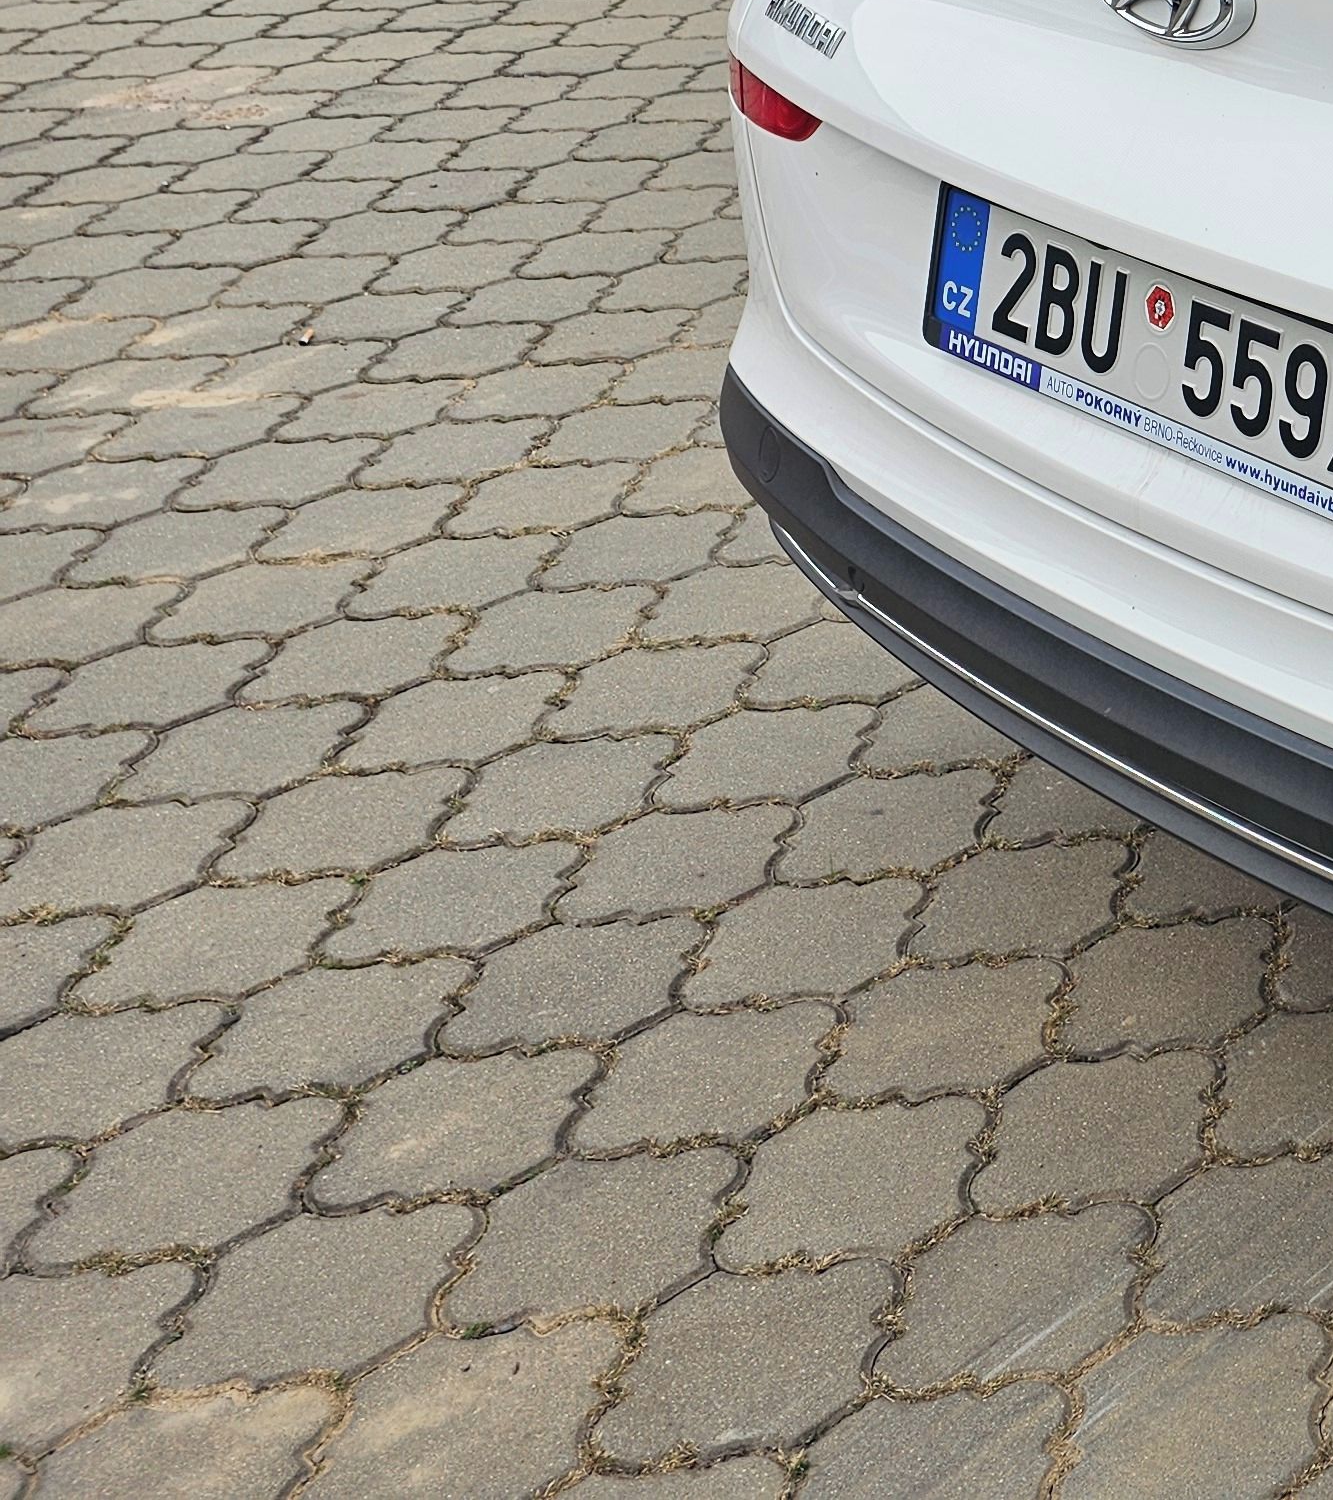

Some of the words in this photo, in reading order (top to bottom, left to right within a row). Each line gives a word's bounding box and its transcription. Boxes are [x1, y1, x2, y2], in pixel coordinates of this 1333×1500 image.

[942, 280, 975, 318] CZ
[991, 232, 1128, 374] 2BU
[948, 330, 1033, 384] HYUNDAI
[1046, 376, 1074, 399] AUTO
[1075, 387, 1142, 428] POKORNÝ
